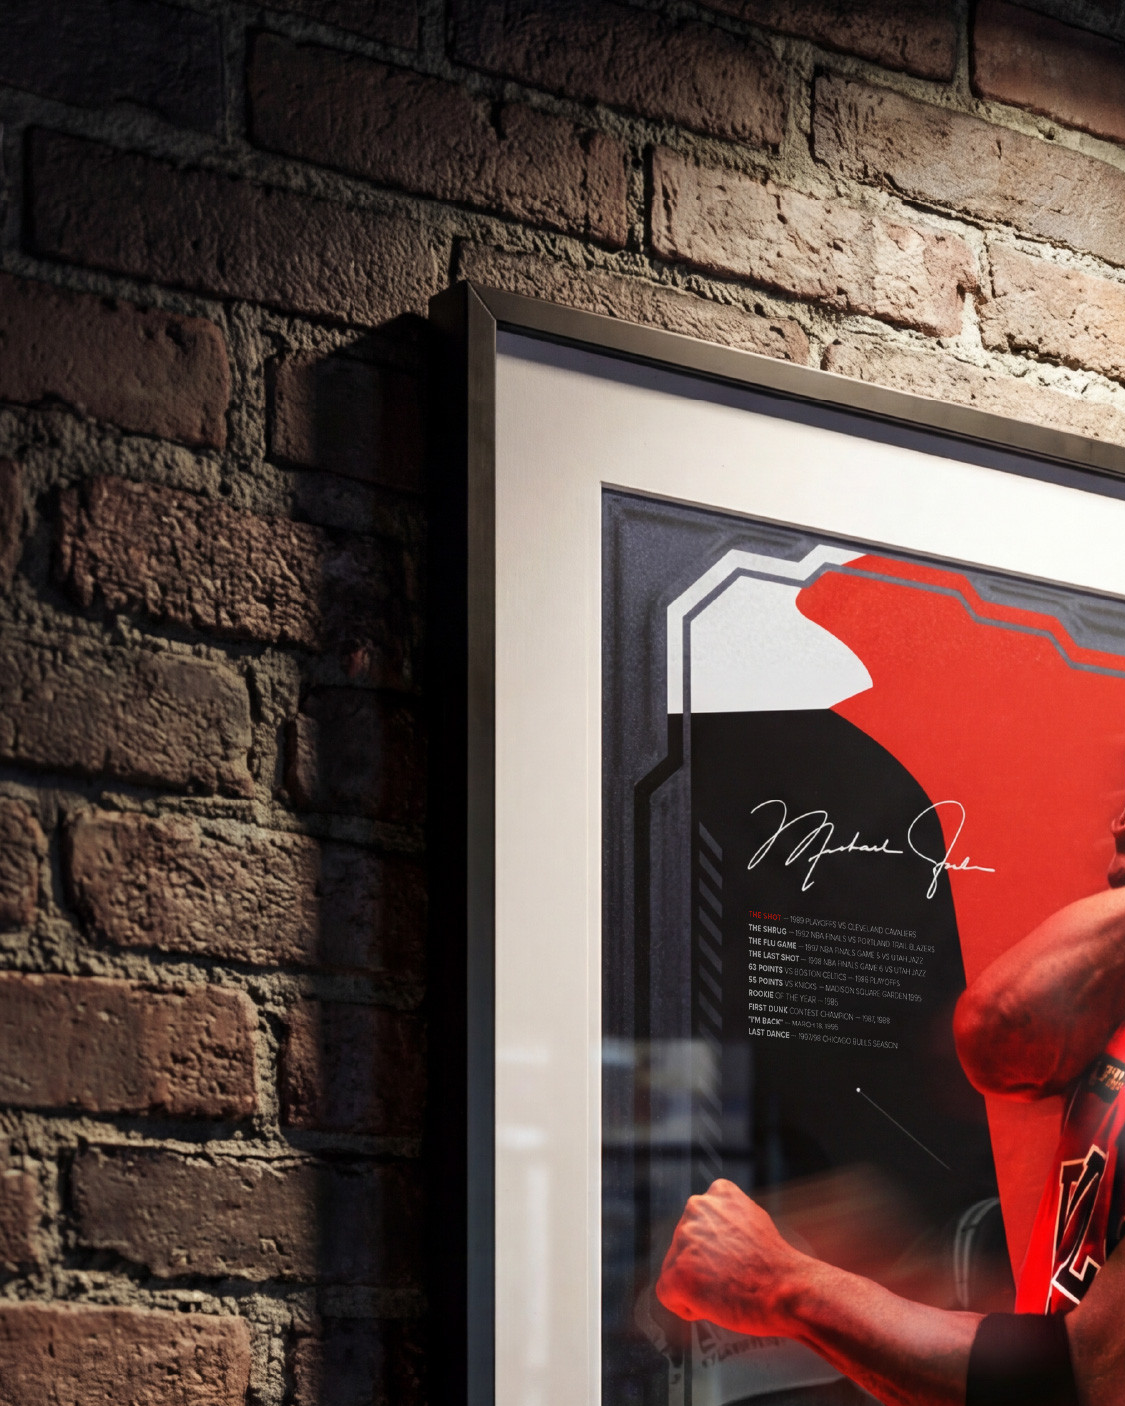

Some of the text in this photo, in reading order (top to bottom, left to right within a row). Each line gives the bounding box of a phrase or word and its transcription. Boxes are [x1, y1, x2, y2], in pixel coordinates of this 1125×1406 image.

[748, 911, 761, 920] THE
[762, 912, 781, 922] SHOT
[748, 923, 761, 933] THE
[762, 925, 786, 935] SHRUG
[748, 937, 761, 946] THE
[763, 938, 776, 947] FLU
[776, 940, 796, 949] GAME
[748, 950, 761, 958] THE
[763, 951, 779, 960] LAST
[780, 953, 799, 963] SHOT
[748, 963, 757, 971] 63
[758, 964, 782, 974] POINTS
[784, 966, 793, 975] VS
[794, 967, 821, 978] BOSTON
[748, 976, 757, 984] 55
[758, 977, 783, 987] POINTS
[784, 979, 793, 988] VS
[748, 989, 773, 999] ROOKIE
[774, 991, 784, 1000] OF
[785, 992, 798, 1001] THE
[799, 994, 816, 1003] YEAR
[748, 1002, 766, 1012] FIRST
[768, 1004, 787, 1014] DUNK
[789, 1006, 818, 1017] CONTEST
[748, 1027, 765, 1037] LAST
[766, 1029, 789, 1039] DANCE
